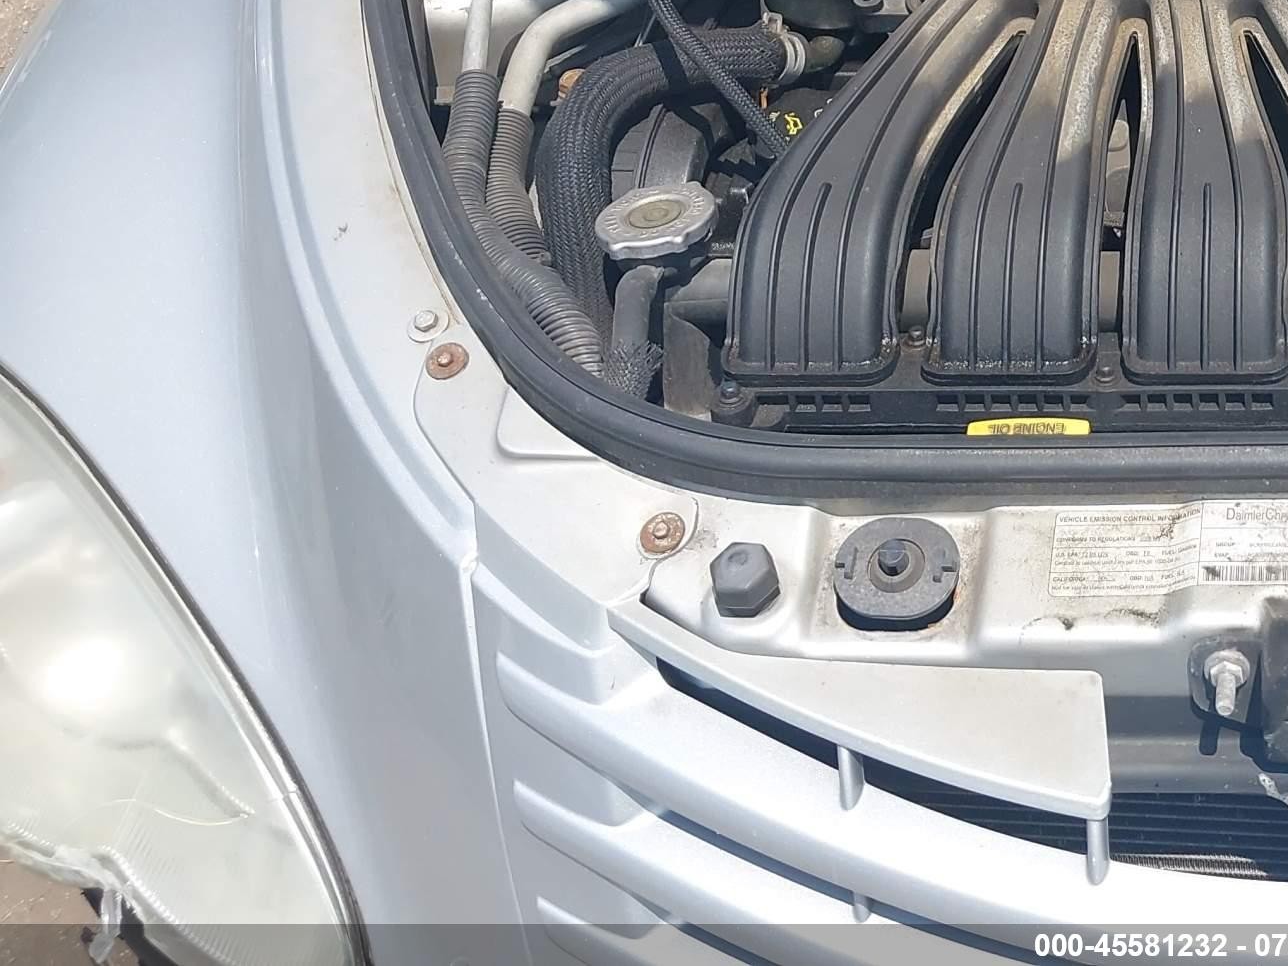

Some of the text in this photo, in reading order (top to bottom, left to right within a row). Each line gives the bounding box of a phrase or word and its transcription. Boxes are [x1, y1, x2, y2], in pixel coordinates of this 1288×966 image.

[987, 422, 1066, 434] ENGINE OIL
[1090, 515, 1122, 523] EMISSION
[1123, 514, 1156, 522] CONTROL
